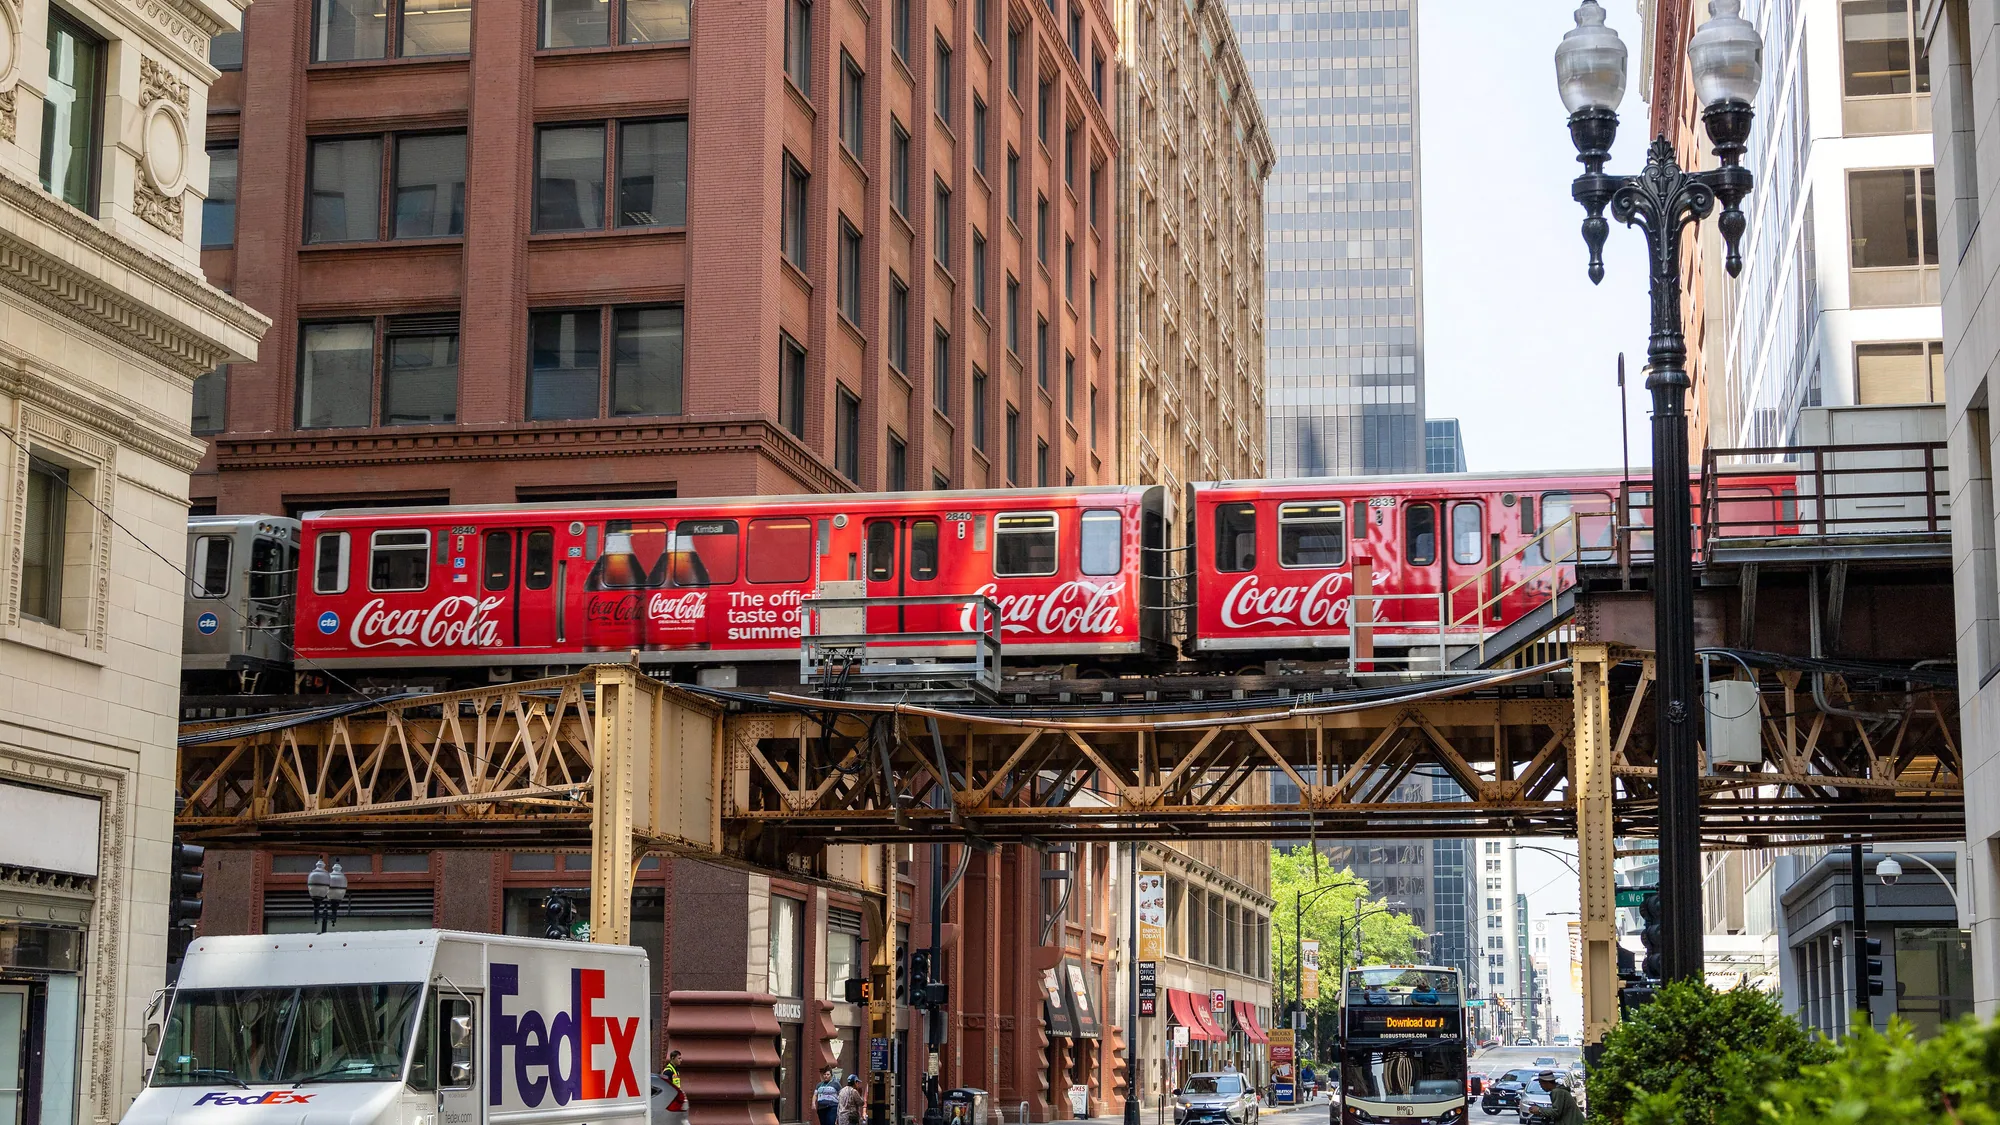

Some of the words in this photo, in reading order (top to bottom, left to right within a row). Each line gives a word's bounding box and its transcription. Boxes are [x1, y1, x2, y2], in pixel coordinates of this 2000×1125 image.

[1369, 499, 1396, 507] 2839
[945, 512, 972, 521] 2840
[452, 526, 476, 534] 2840
[693, 525, 724, 533] Kimball
[728, 591, 764, 607] The
[648, 592, 707, 620] Coca-Cola
[727, 608, 777, 623] taste
[782, 606, 801, 622] of
[200, 619, 216, 627] cta
[321, 619, 337, 627] cta
[350, 596, 505, 648] Coca-Cola
[773, 1004, 800, 1018] ARBUCKS
[1142, 1003, 1153, 1011] MR
[1387, 1017, 1423, 1027] Download
[1425, 1019, 1437, 1027] our
[490, 963, 641, 1108] FedEx
[193, 1091, 317, 1106] FedEx
[445, 1111, 472, 1124] fedex.com
